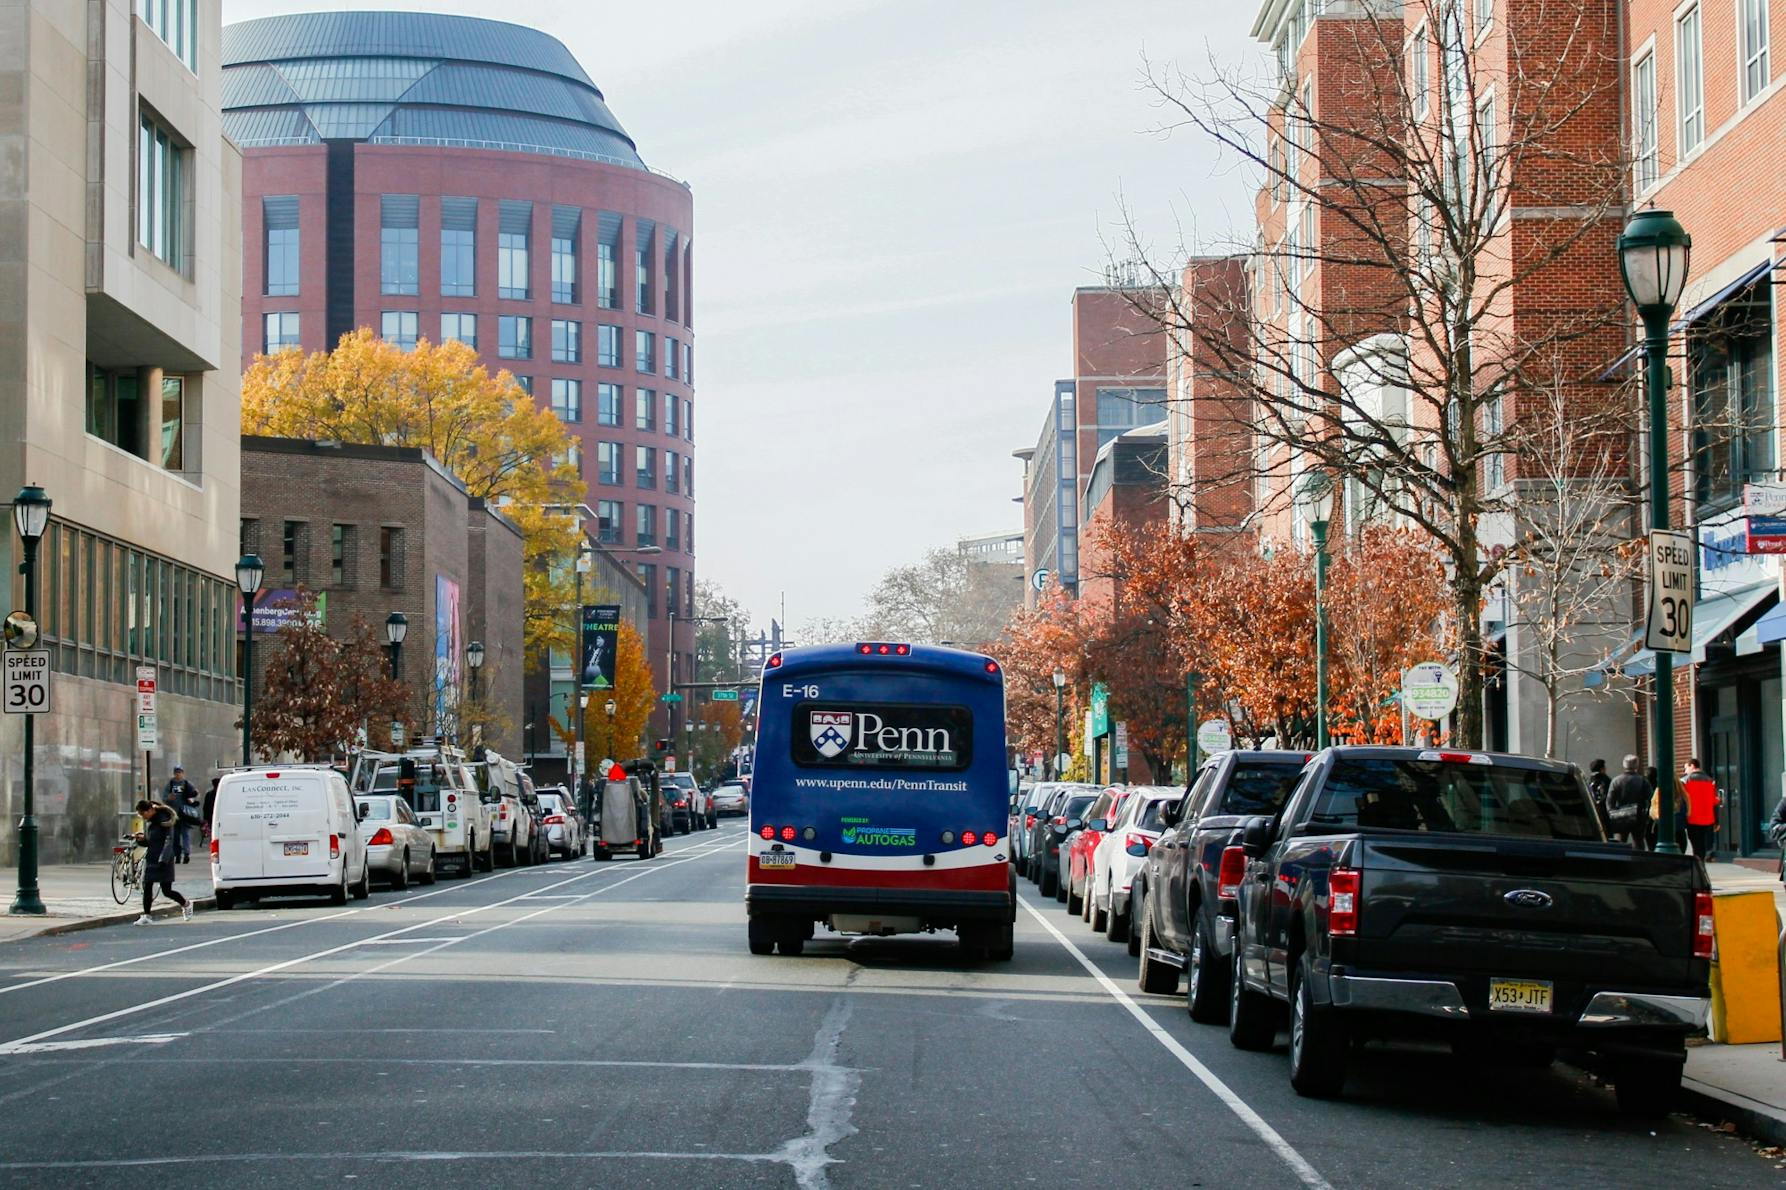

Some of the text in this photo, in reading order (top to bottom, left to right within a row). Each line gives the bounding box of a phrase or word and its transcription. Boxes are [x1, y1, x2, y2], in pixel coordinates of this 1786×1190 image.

[1656, 546, 1689, 566] SPEED
[1662, 571, 1687, 591] LIMIT
[1659, 596, 1689, 639] 30
[583, 623, 620, 631] THEATRE
[8, 657, 46, 668] SPEED
[12, 671, 42, 681] LIMIT
[10, 684, 45, 706] 30
[782, 684, 819, 698] E-16
[854, 713, 953, 752] Penn
[903, 752, 952, 761] PENNSYLVANIA
[795, 778, 968, 791] www.upenn.edu/PennTransit
[856, 834, 916, 846] AUTOGAS
[1494, 987, 1549, 1005] X53 JTF
